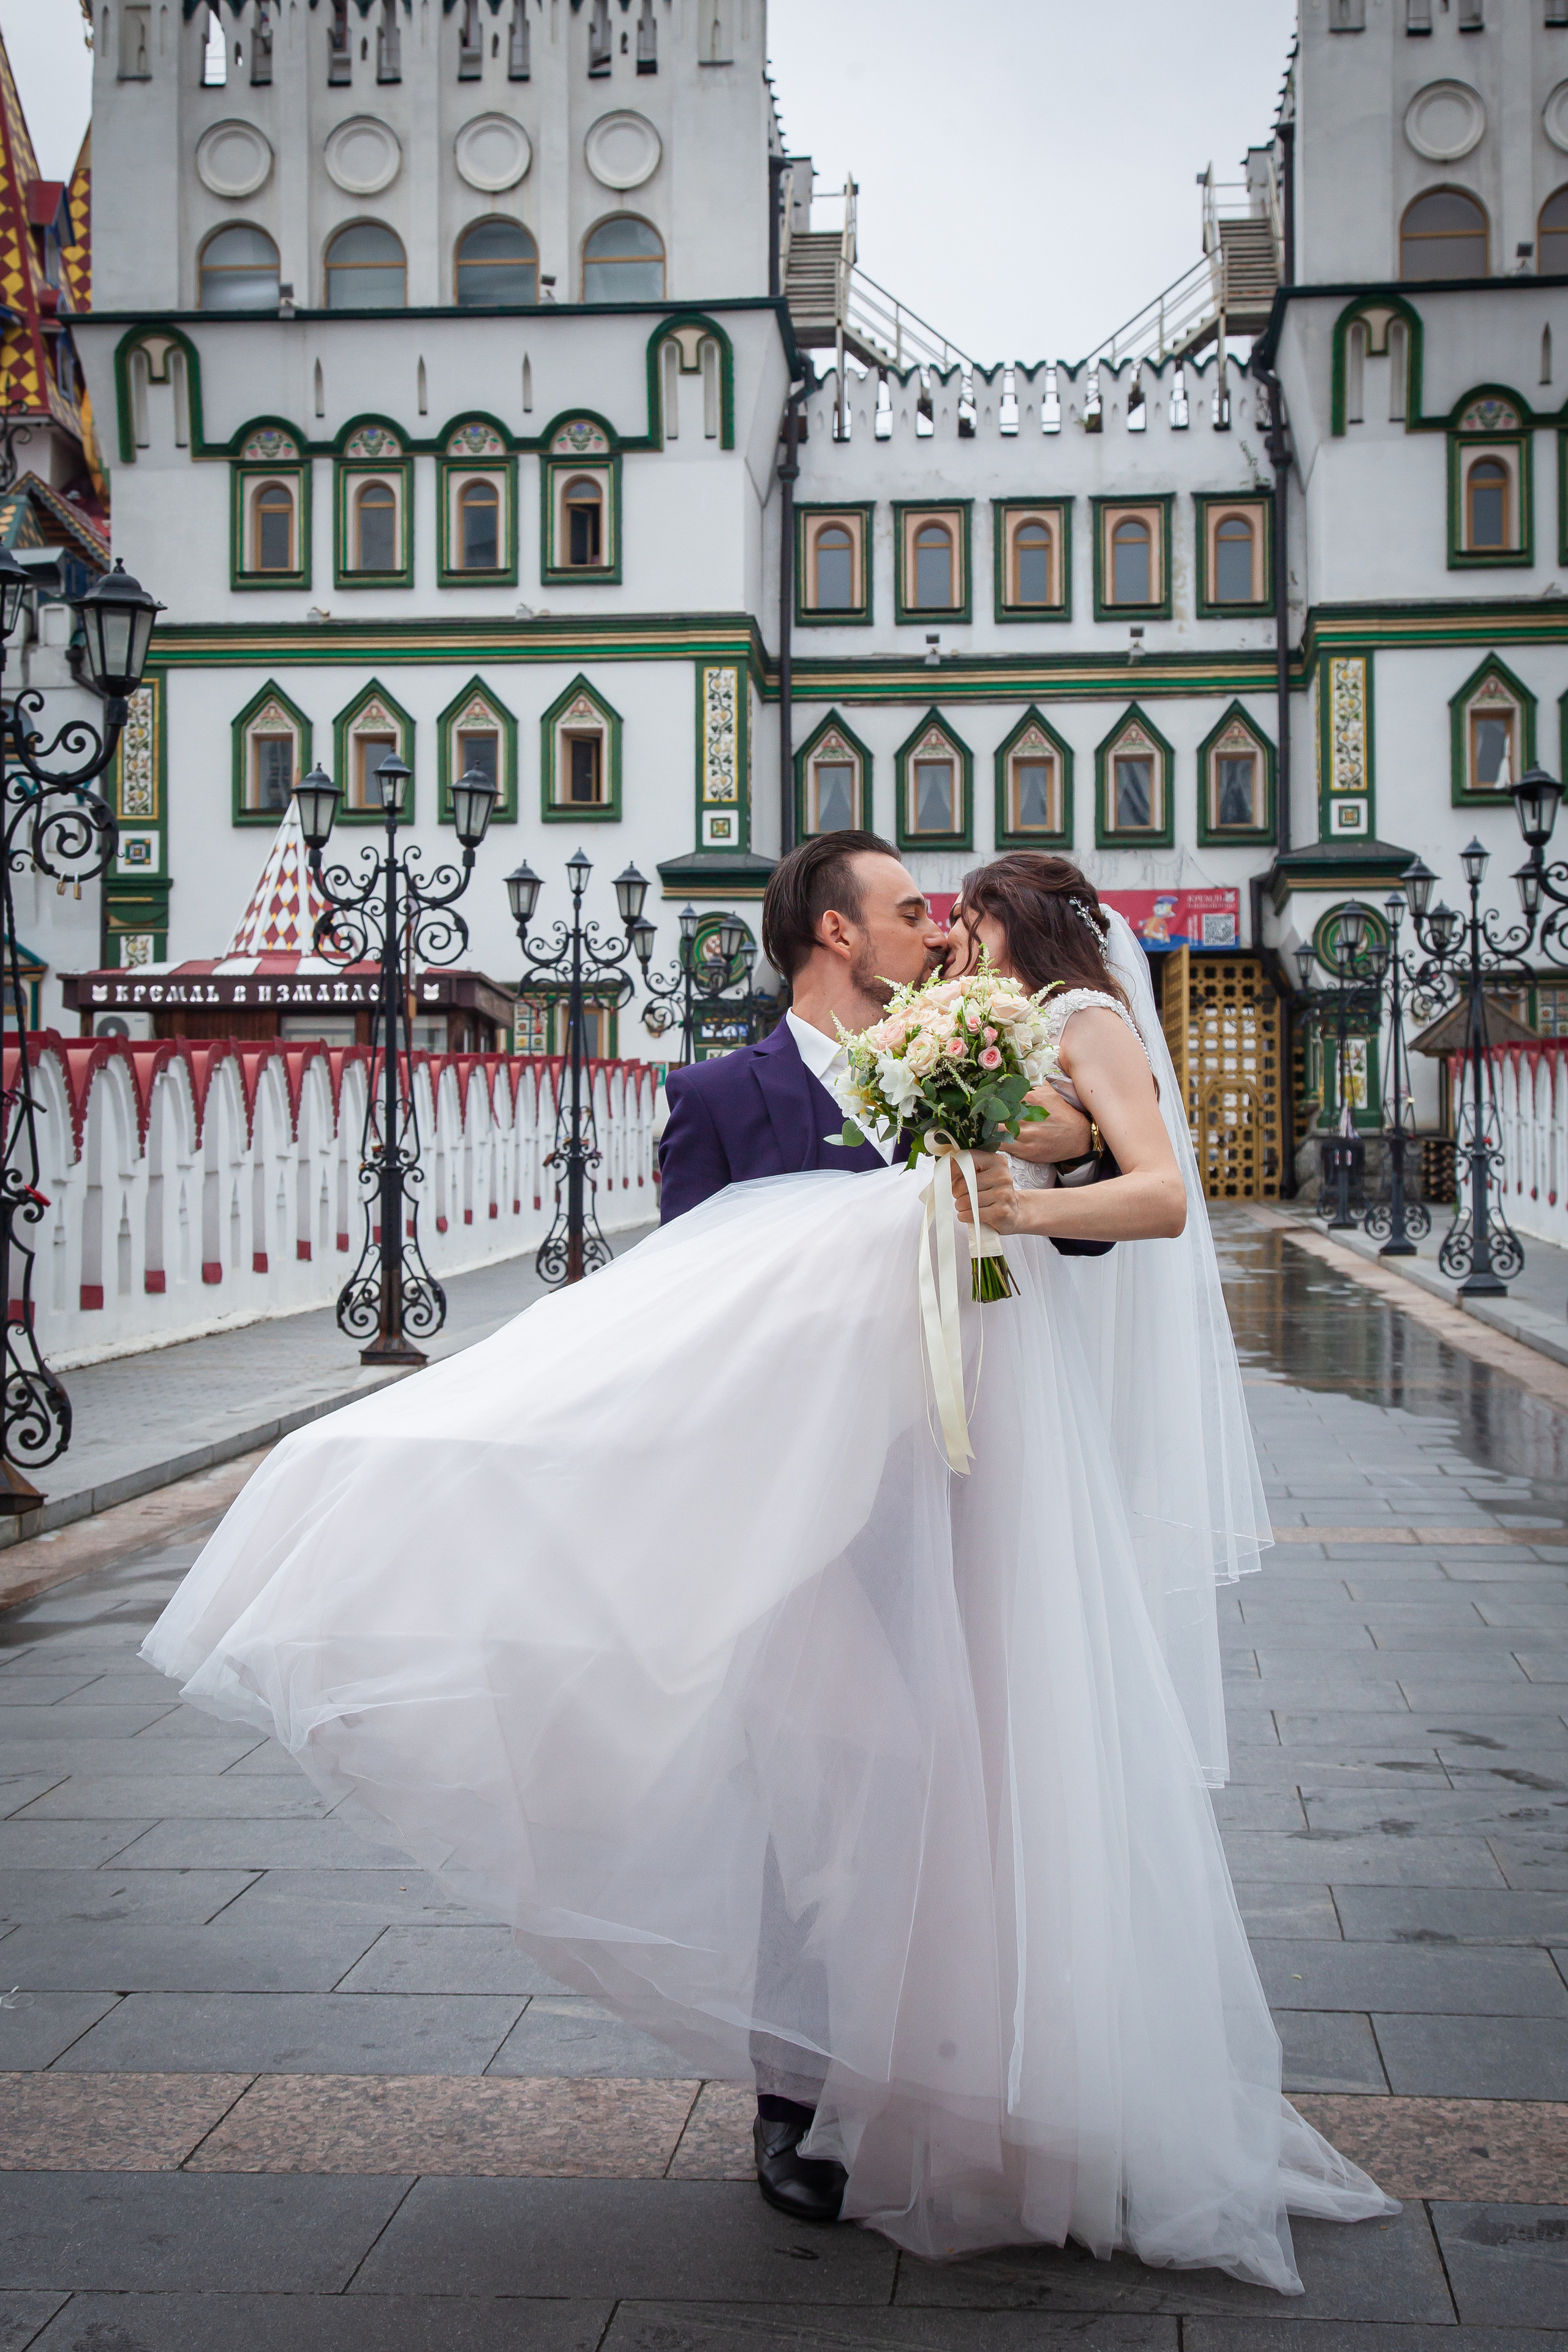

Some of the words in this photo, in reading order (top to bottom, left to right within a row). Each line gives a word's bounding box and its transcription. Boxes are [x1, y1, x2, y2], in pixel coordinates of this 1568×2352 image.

[115, 985, 219, 1002] КРЕМЛЬ
[232, 985, 246, 1002] В
[257, 981, 407, 1003] ИЗМАЙЛО
